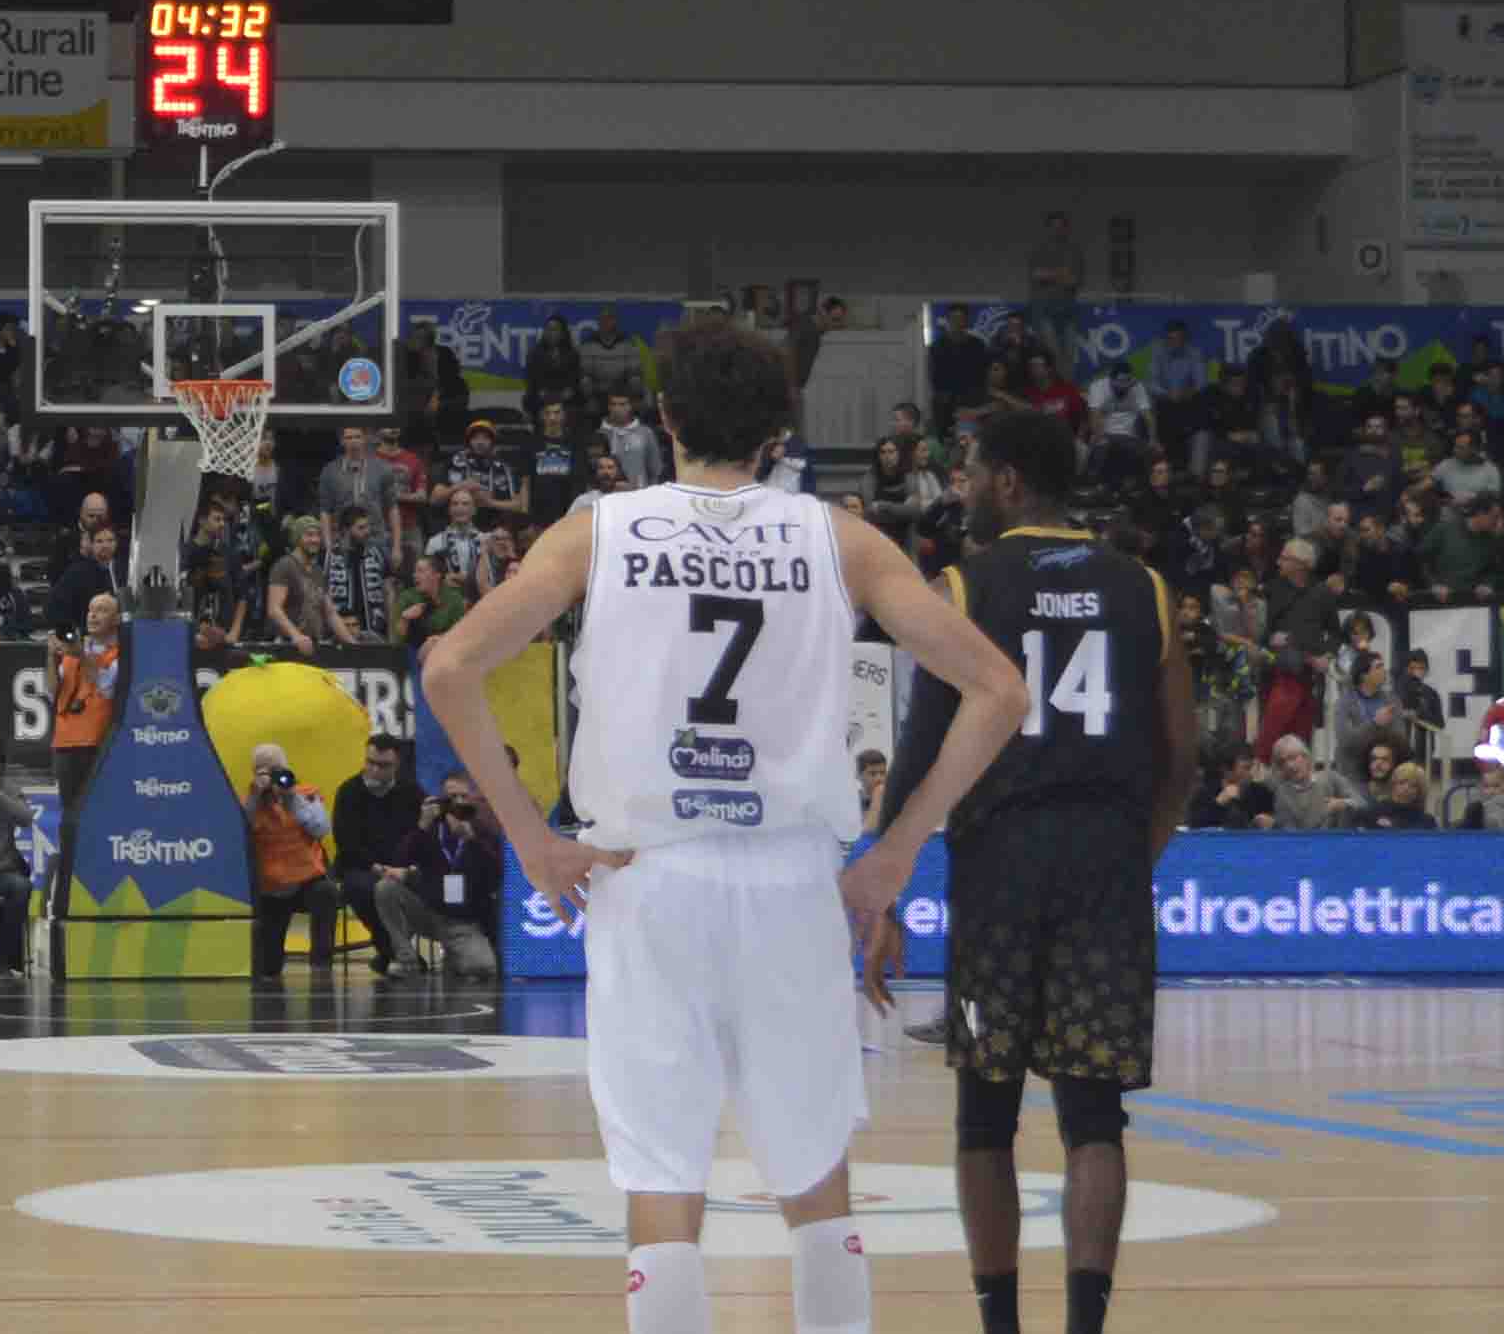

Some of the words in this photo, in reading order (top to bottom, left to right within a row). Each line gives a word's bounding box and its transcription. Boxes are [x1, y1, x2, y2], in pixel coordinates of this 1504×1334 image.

[150, 3, 267, 38] 04:32
[152, 46, 262, 115] 24
[628, 517, 802, 545] CAVIT
[623, 552, 811, 592] PASCOLO
[1030, 590, 1100, 619] JONES
[686, 593, 764, 724] 7
[1022, 629, 1113, 736] 14
[132, 727, 191, 746] TRENTINO
[671, 746, 752, 769] Melinda
[133, 779, 192, 798] TRENTINO
[676, 795, 758, 819] TRENTINO
[108, 834, 214, 866] TRENTINO
